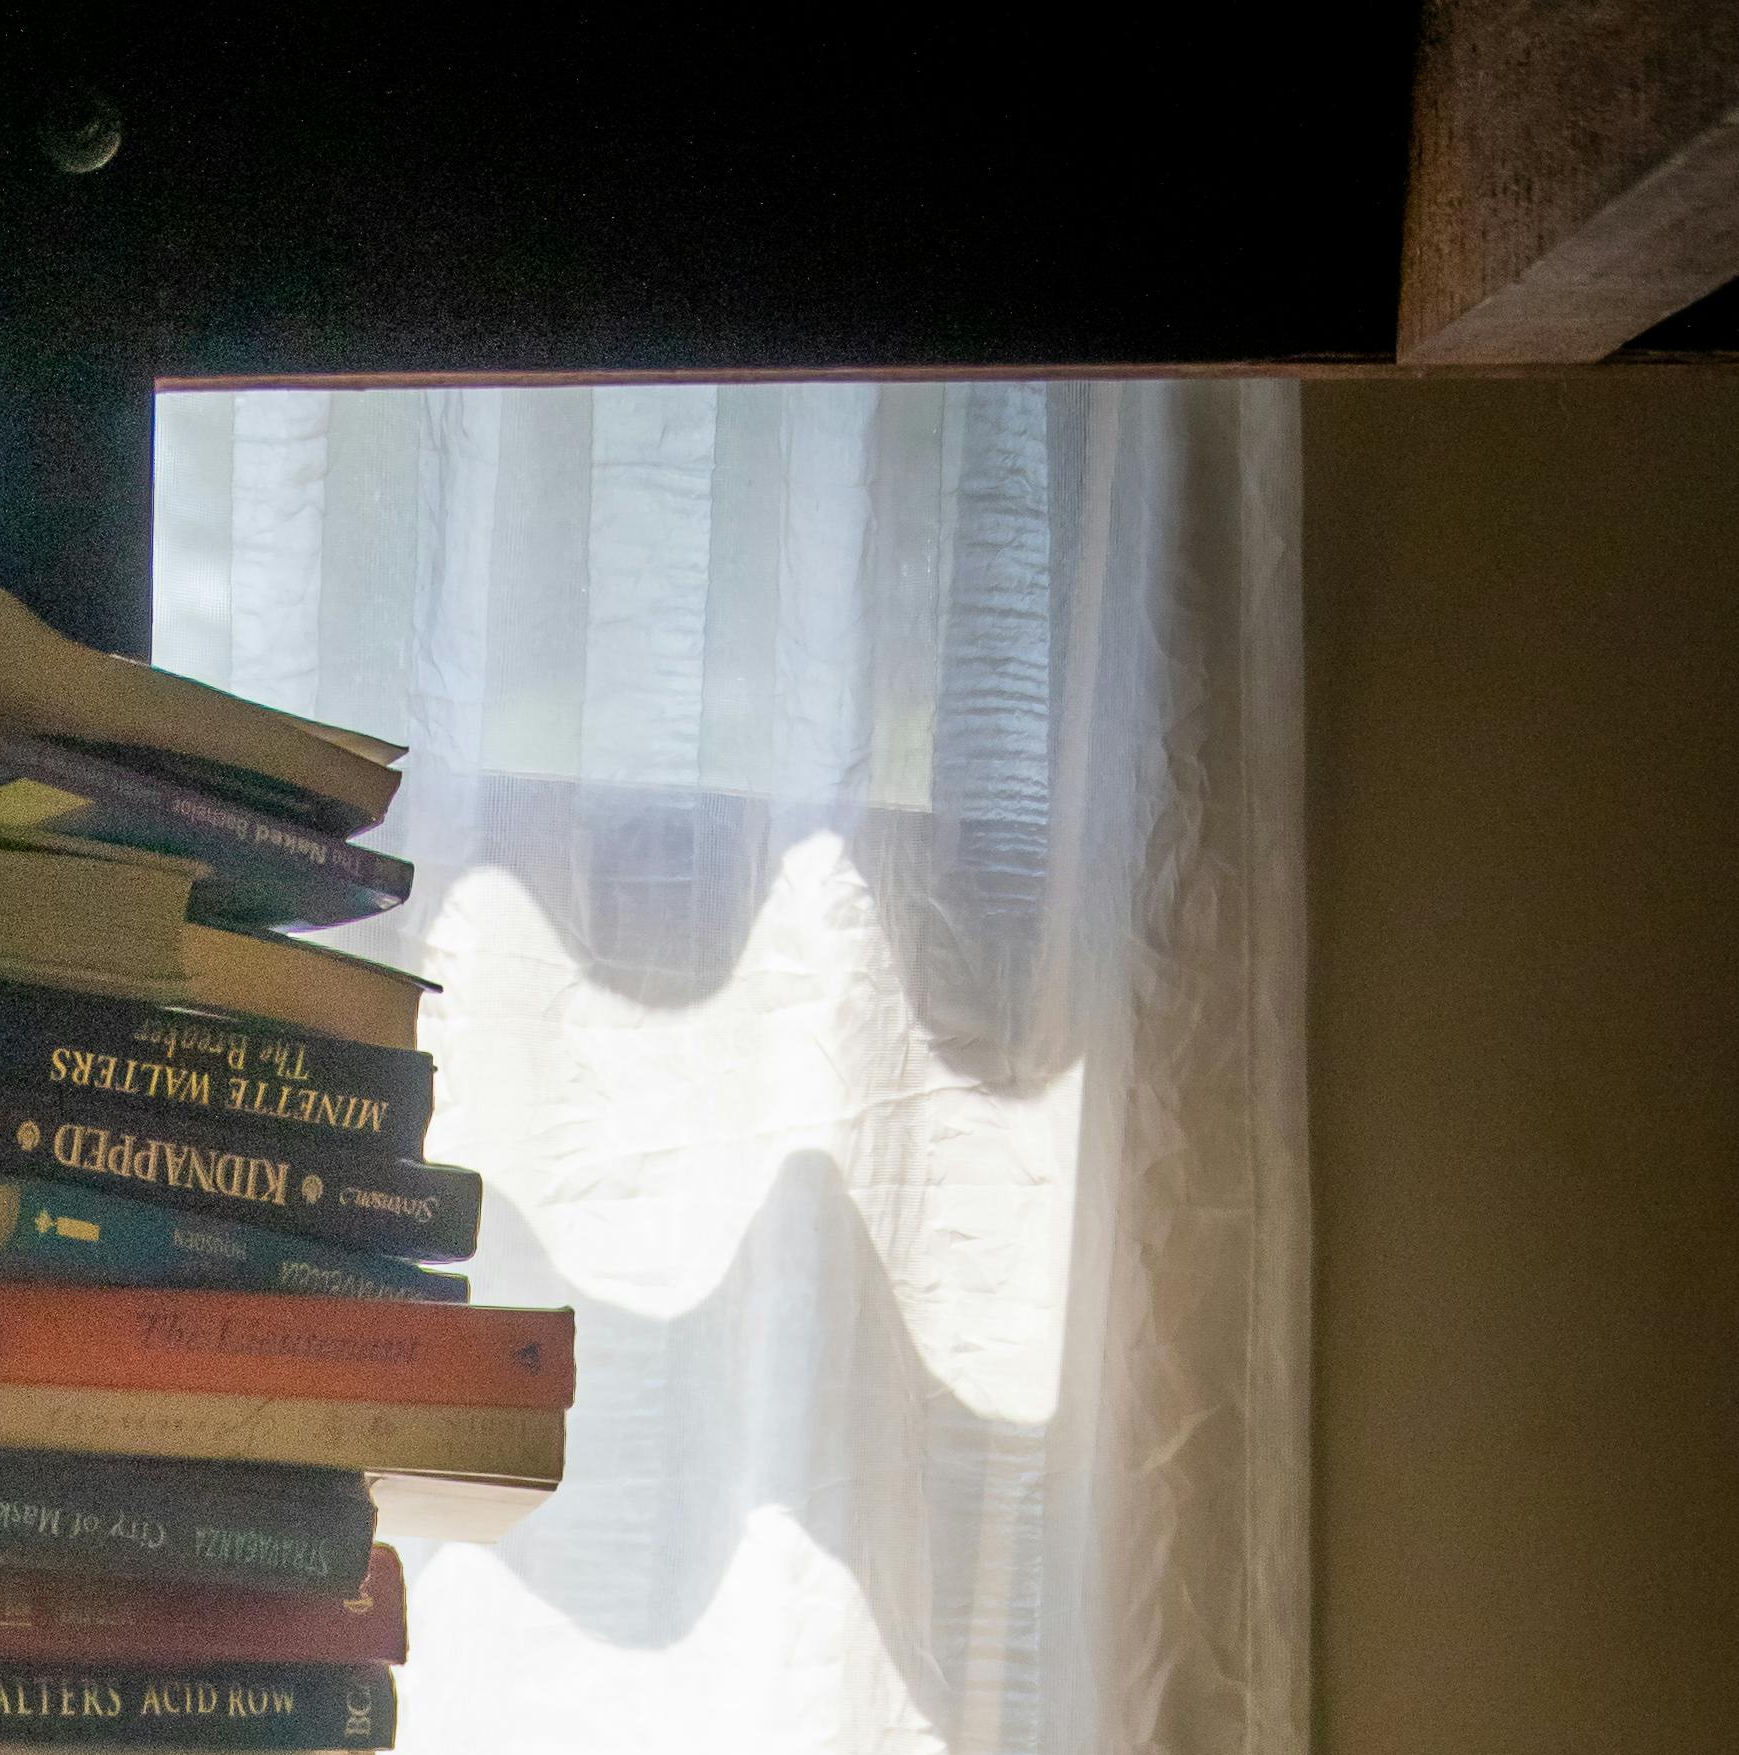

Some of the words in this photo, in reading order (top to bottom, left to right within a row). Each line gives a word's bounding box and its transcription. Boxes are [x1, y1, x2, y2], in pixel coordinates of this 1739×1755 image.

[48, 1045, 212, 1105] WALTERS
[256, 1037, 312, 1080] The
[226, 1075, 387, 1132] MINETTE
[52, 1121, 289, 1205] KIDNAPPED
[72, 1510, 99, 1537] of
[107, 1509, 166, 1548] City
[141, 1680, 219, 1714] ACID
[228, 1683, 296, 1713] ROW
